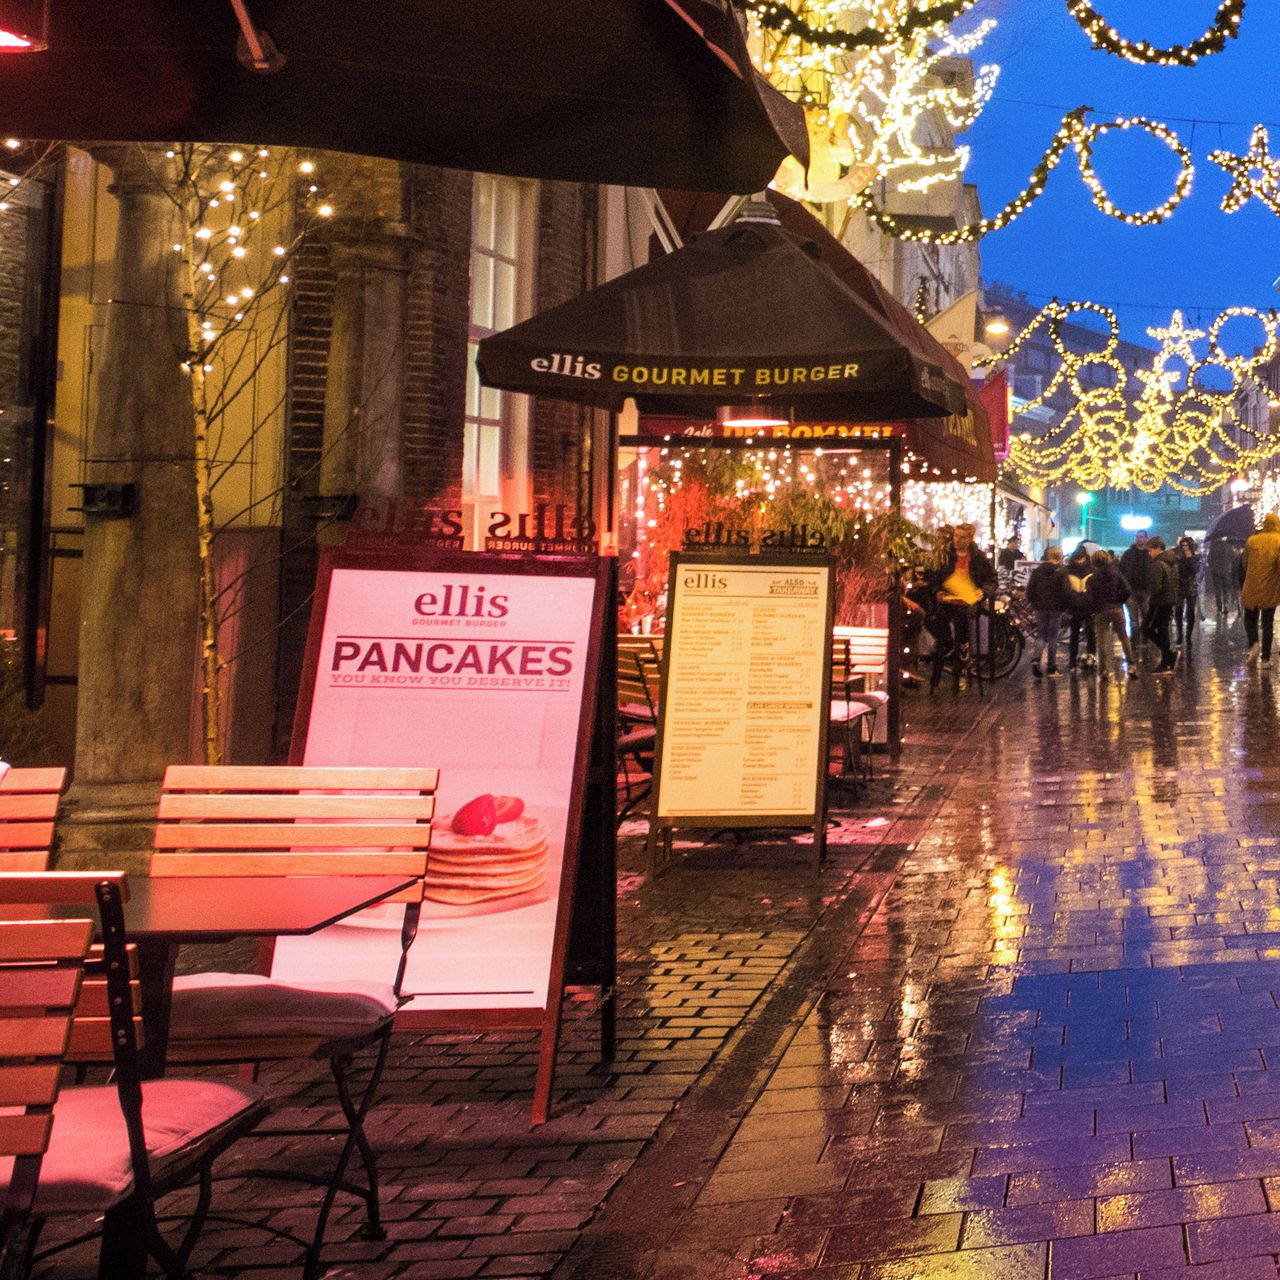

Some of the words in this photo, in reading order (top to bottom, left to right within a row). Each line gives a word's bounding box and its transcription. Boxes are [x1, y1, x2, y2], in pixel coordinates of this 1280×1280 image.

[530, 353, 601, 380] ellis
[612, 365, 745, 386] GOURMET
[755, 363, 859, 386] BURGER
[683, 573, 727, 589] ellis
[784, 578, 804, 586] ALSO
[414, 585, 509, 618] ellis
[412, 618, 463, 627] GOURMET
[466, 619, 507, 628] BURGER
[331, 641, 573, 676] PANCAKES
[332, 674, 368, 684] YOU
[370, 675, 425, 685] KNOW
[429, 676, 463, 686] YOU
[467, 677, 545, 687] DESERVE
[550, 678, 571, 688] IT!
